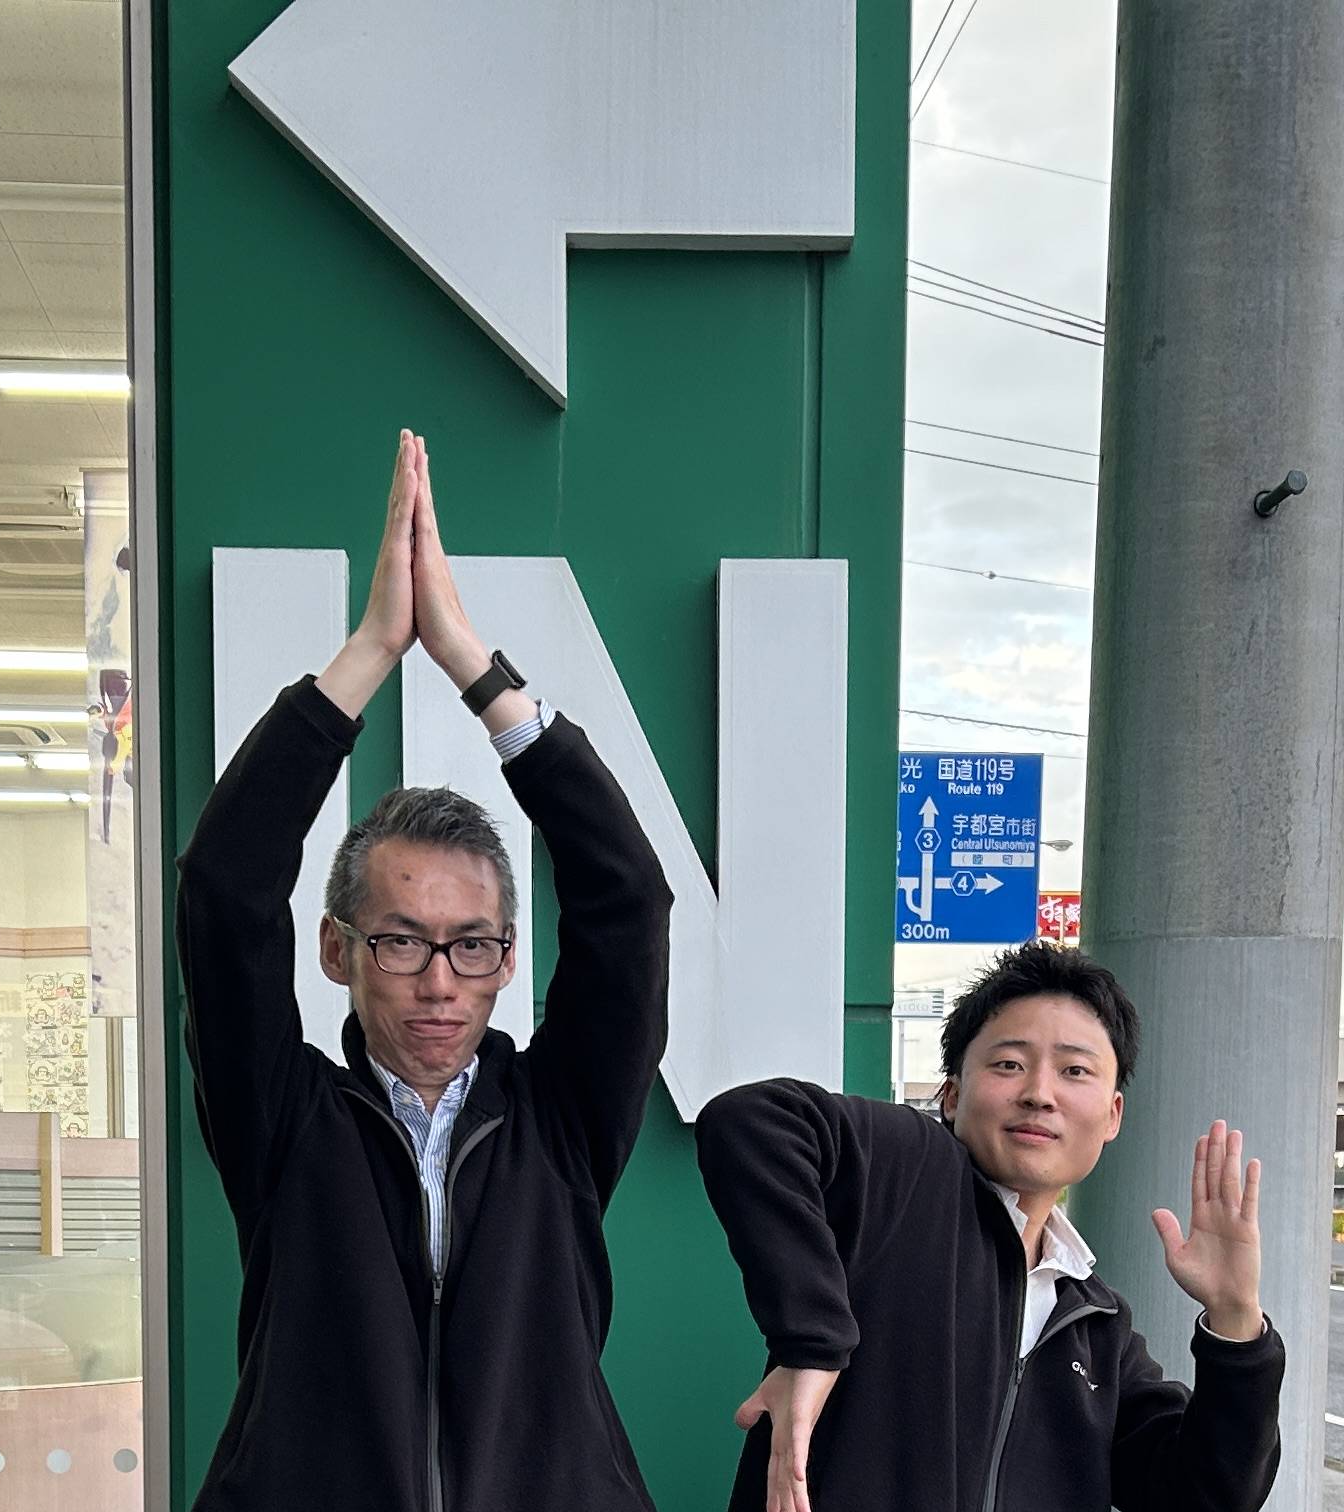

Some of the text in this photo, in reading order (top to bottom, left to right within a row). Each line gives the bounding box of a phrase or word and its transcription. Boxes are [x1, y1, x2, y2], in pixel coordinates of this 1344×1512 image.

[938, 759, 1015, 781] 国道119号
[948, 783, 981, 795] Route
[986, 783, 1004, 795] 119
[952, 814, 1036, 836] 宇都宮市街
[923, 833, 933, 848] 3
[951, 838, 1035, 853] Central Utsunomiya
[957, 877, 968, 890] 4
[901, 924, 950, 939] 300m
